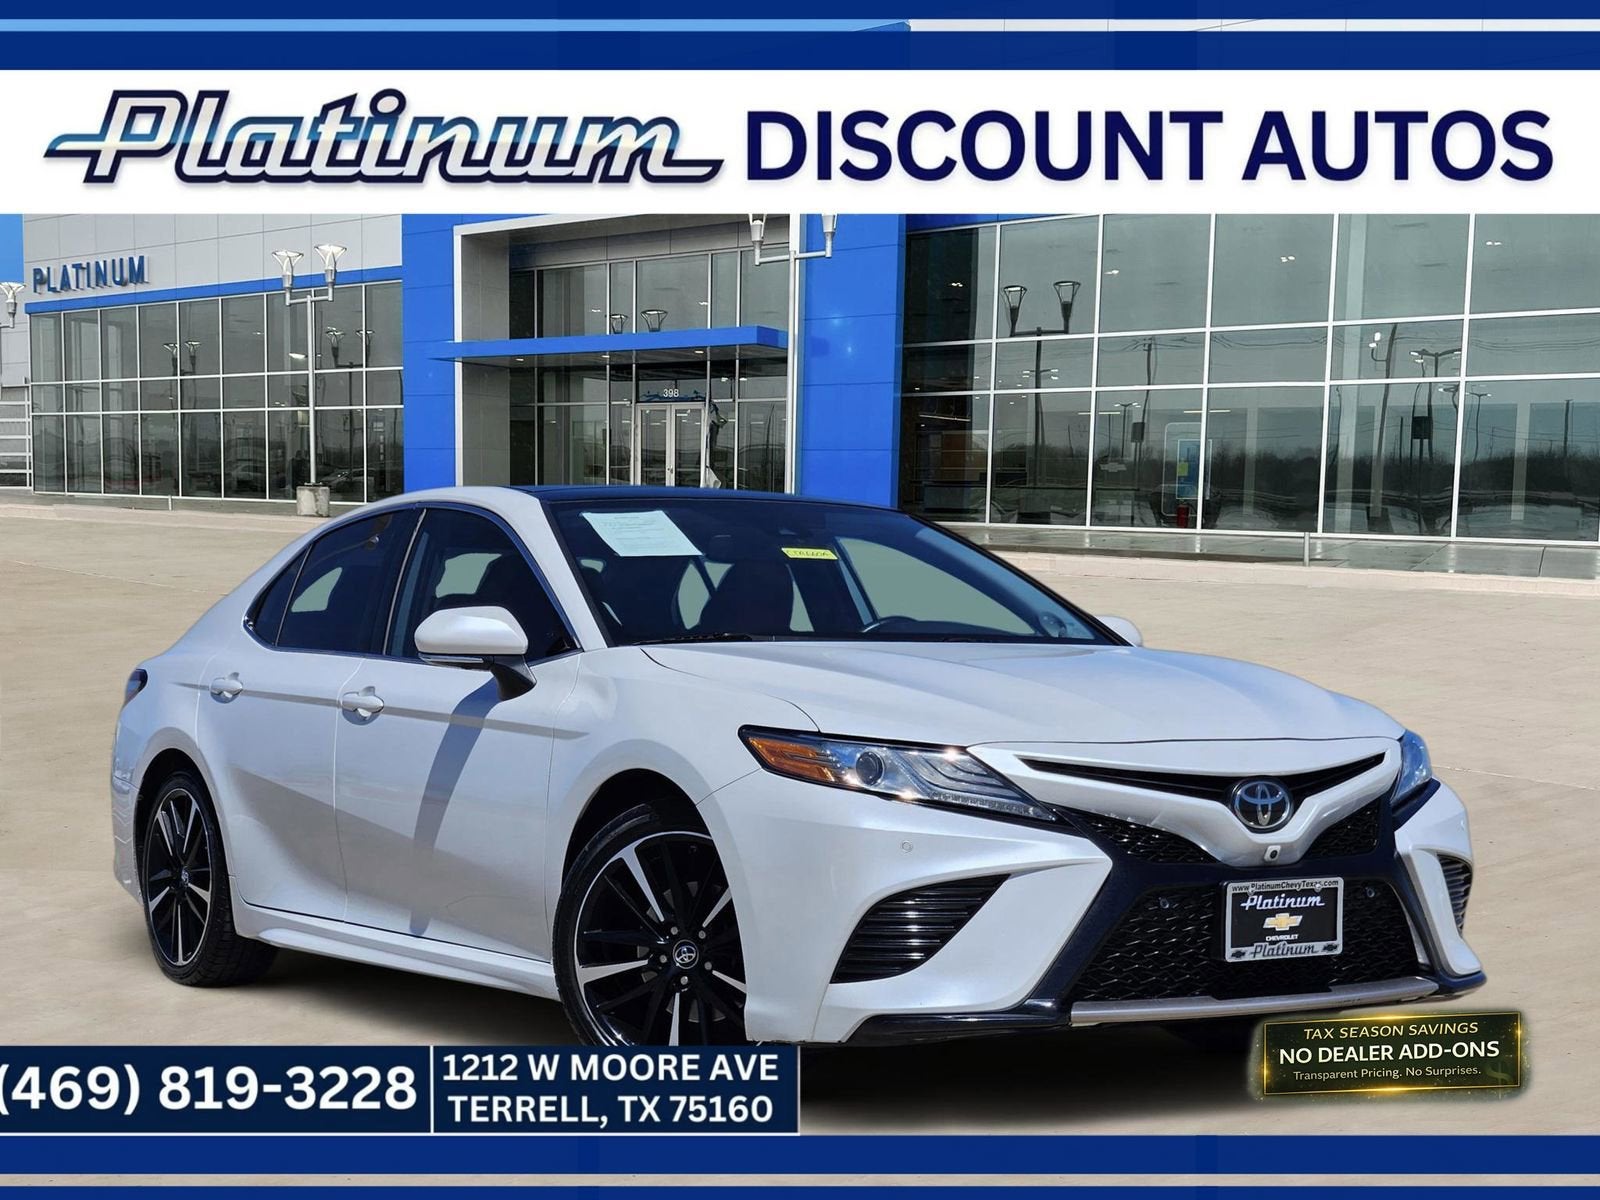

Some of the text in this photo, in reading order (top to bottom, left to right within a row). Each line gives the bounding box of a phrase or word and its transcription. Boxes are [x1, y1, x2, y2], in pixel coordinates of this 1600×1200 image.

[33, 255, 146, 294] PLATINUM
[663, 388, 679, 398] 398
[1233, 880, 1338, 891] wwwPlatinumChevyTexa.com
[1241, 893, 1325, 910] Platinum
[1250, 942, 1319, 958] Platinum
